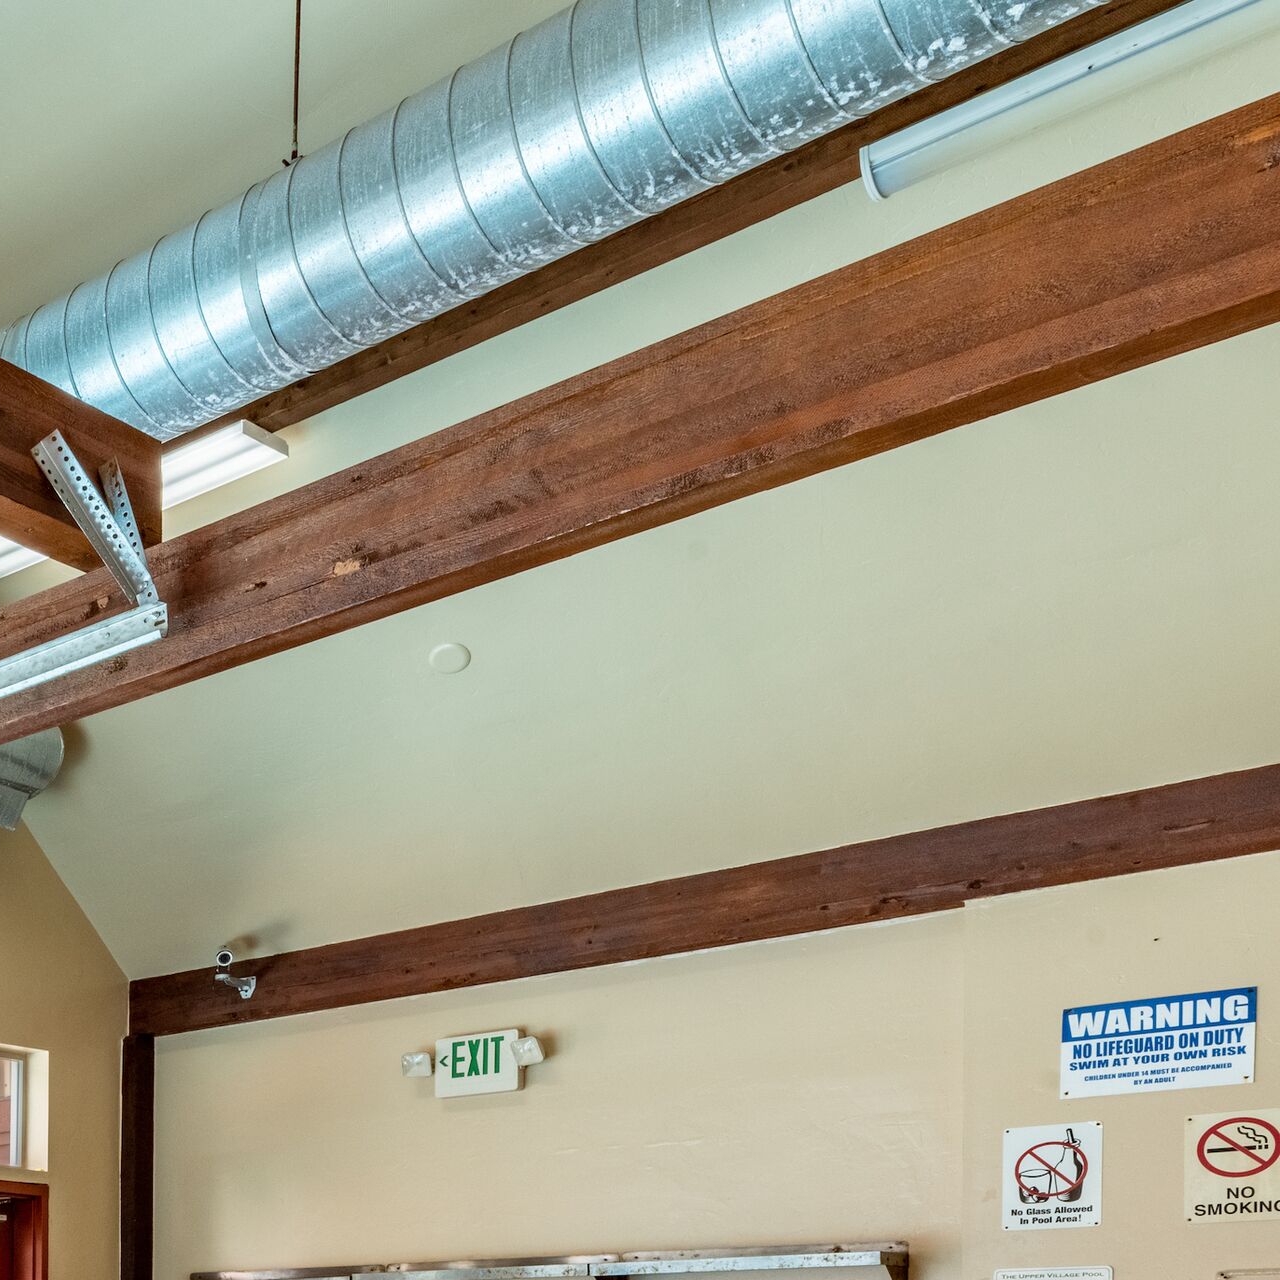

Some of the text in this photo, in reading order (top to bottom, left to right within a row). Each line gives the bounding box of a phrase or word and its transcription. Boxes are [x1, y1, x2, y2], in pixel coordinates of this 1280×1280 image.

[1068, 995, 1249, 1038] WARNING
[1073, 1027, 1244, 1060] NO LIFEGUARD ON DUTY
[451, 1036, 504, 1078] EXIT
[1069, 1045, 1246, 1071] SWIM AT YOUR OWN RISK
[1084, 1074, 1116, 1082] CHILDREN
[1118, 1071, 1140, 1079] UNDER
[1150, 1068, 1169, 1076] MUST
[1181, 1062, 1232, 1073] ACCOMPANIED
[1227, 1186, 1255, 1199] NO
[1032, 1216, 1052, 1224] Pool
[1055, 1214, 1082, 1223] Area!
[1054, 1205, 1093, 1214] Allowed
